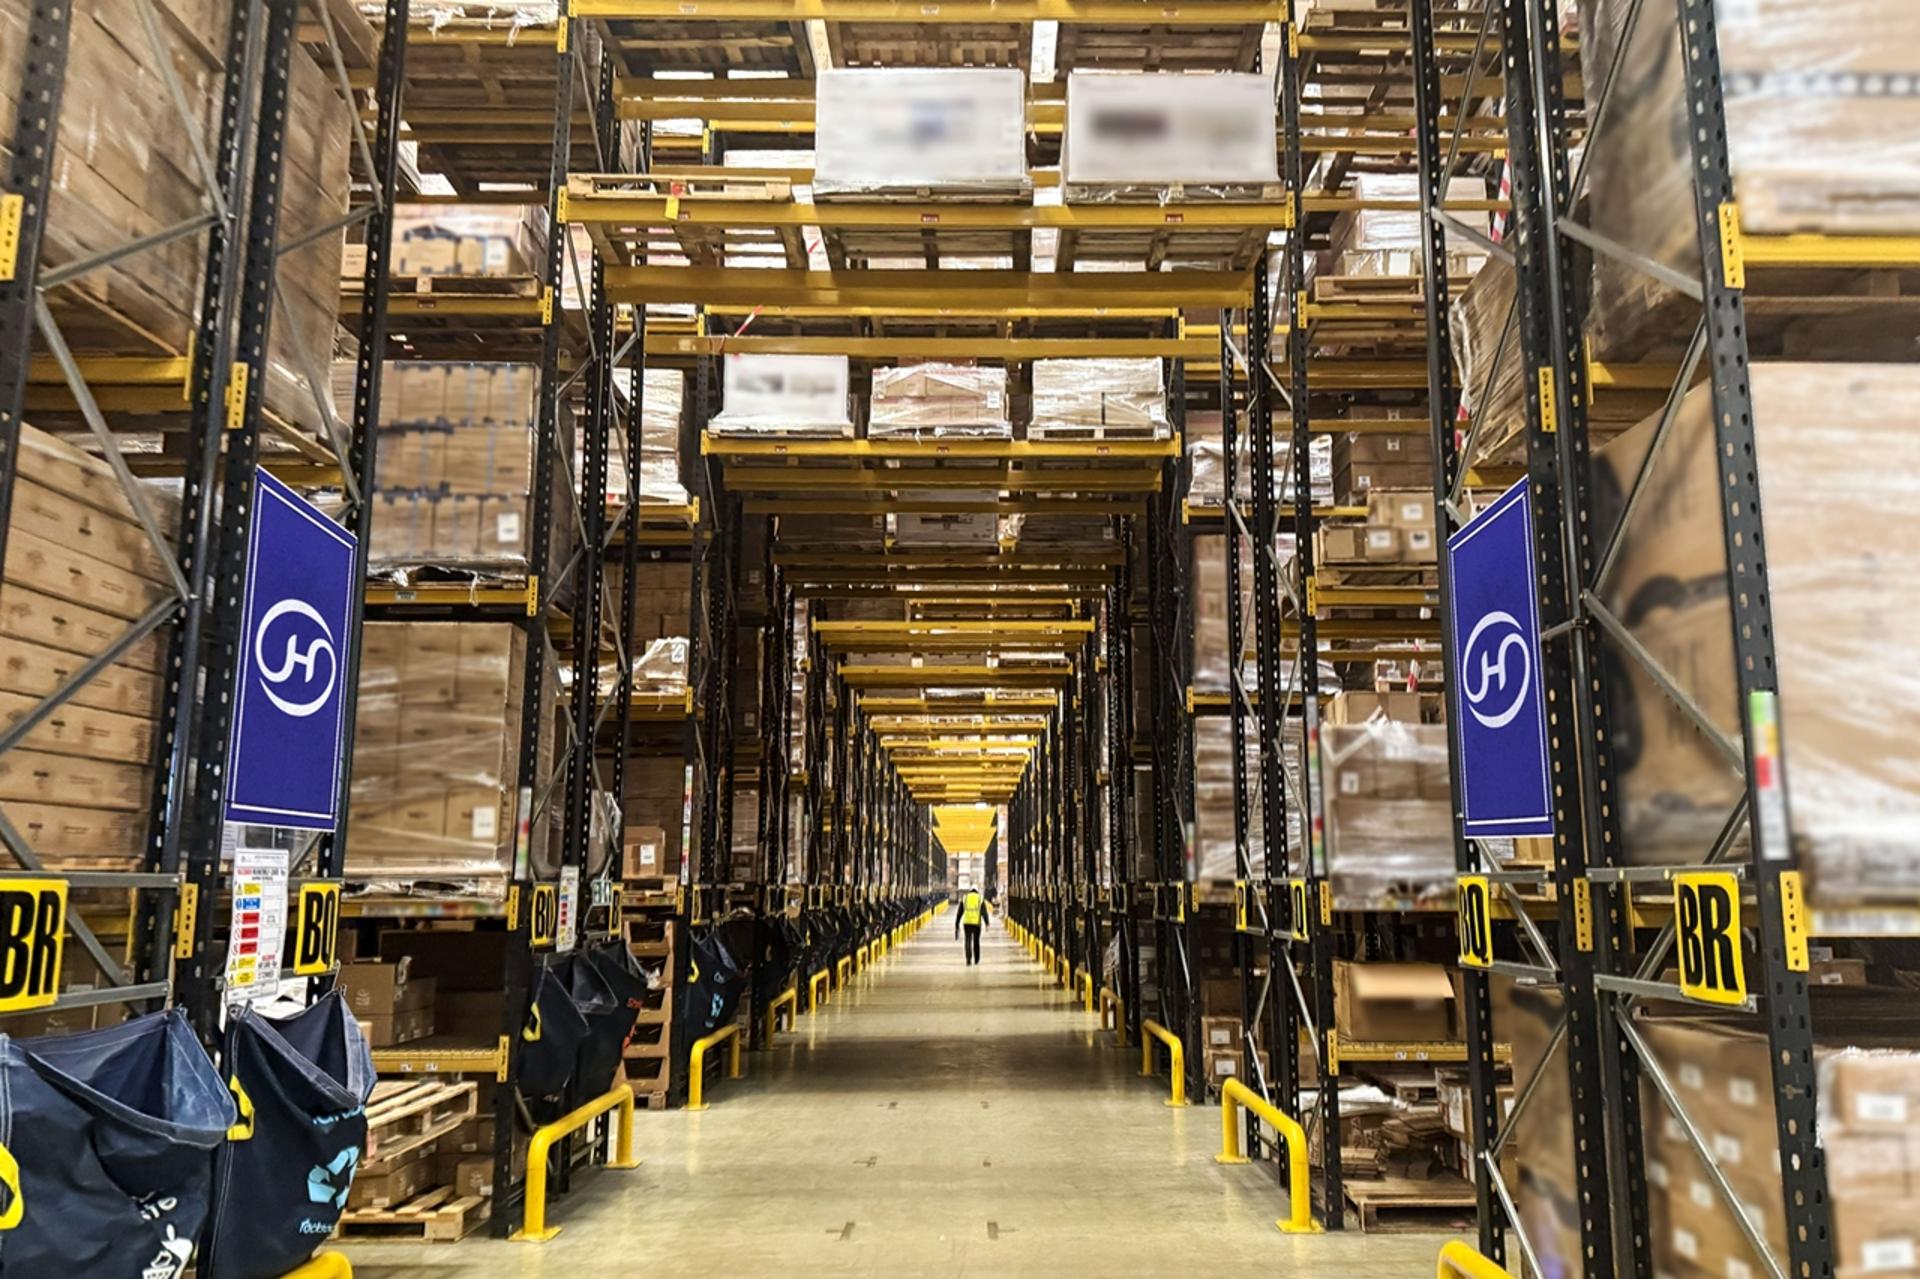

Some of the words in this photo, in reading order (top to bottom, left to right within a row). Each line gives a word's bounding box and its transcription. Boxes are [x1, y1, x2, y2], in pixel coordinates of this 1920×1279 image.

[0, 890, 60, 998] BR
[299, 889, 336, 969] BQ
[1678, 884, 1739, 992] BR
